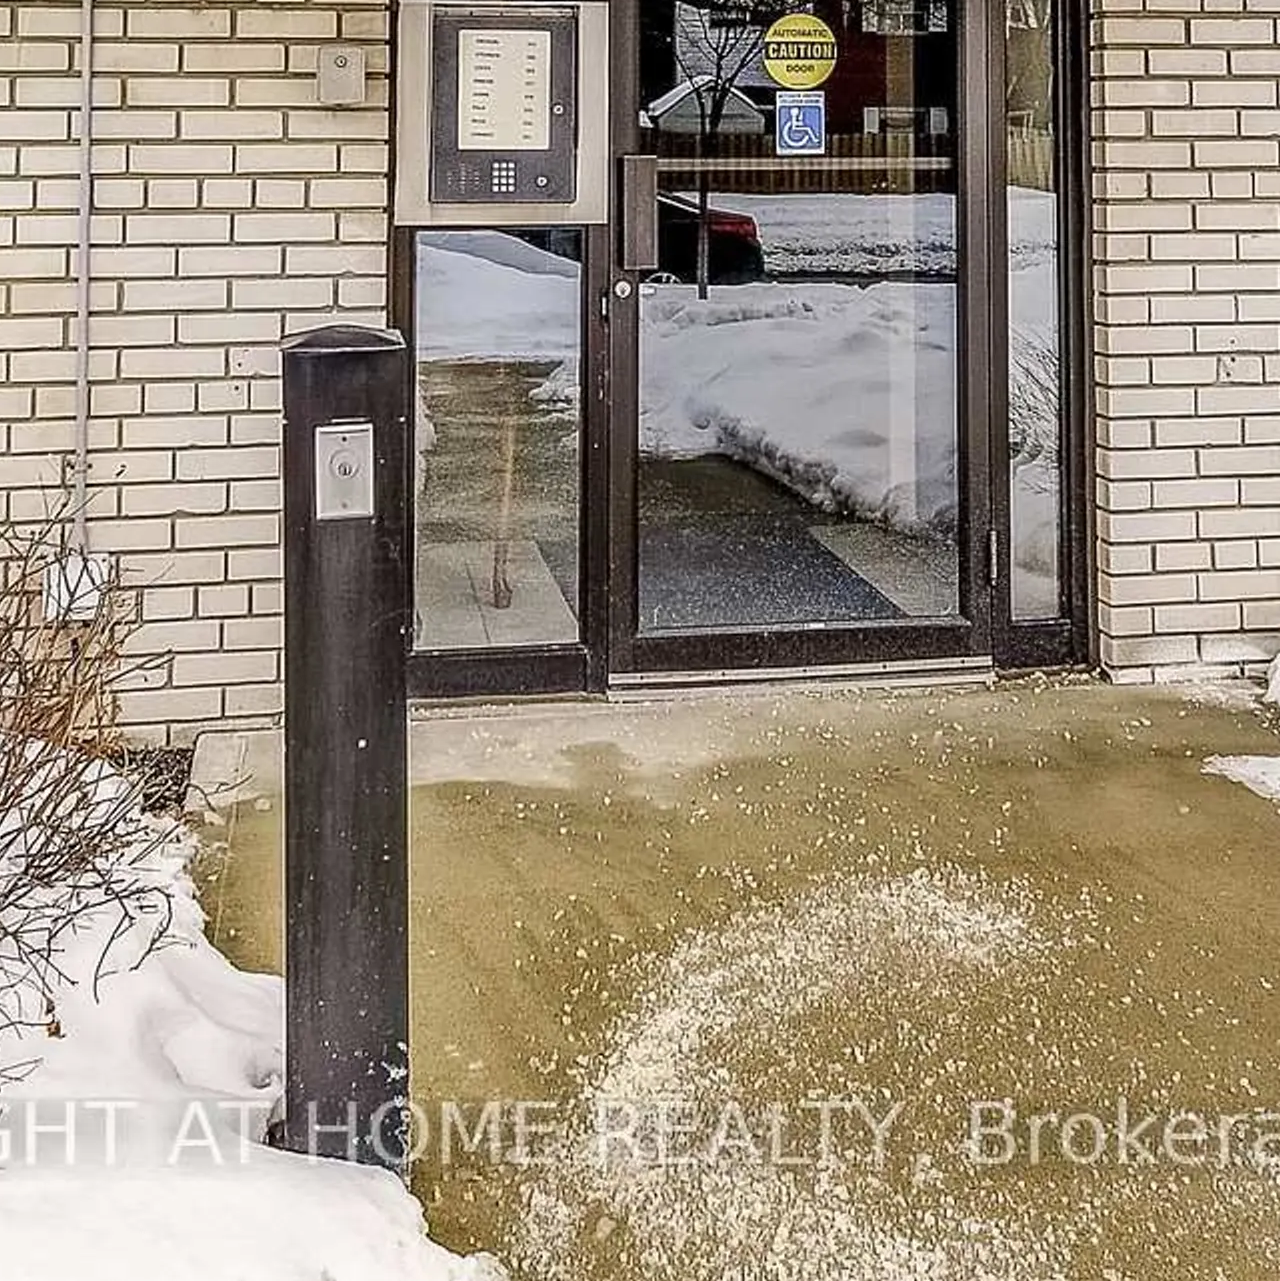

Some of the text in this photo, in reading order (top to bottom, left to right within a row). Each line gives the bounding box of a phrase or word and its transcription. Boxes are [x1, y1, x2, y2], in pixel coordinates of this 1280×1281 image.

[772, 28, 828, 38] AUTOMATIC
[769, 43, 832, 58] CAUTION
[786, 64, 815, 73] DOOR
